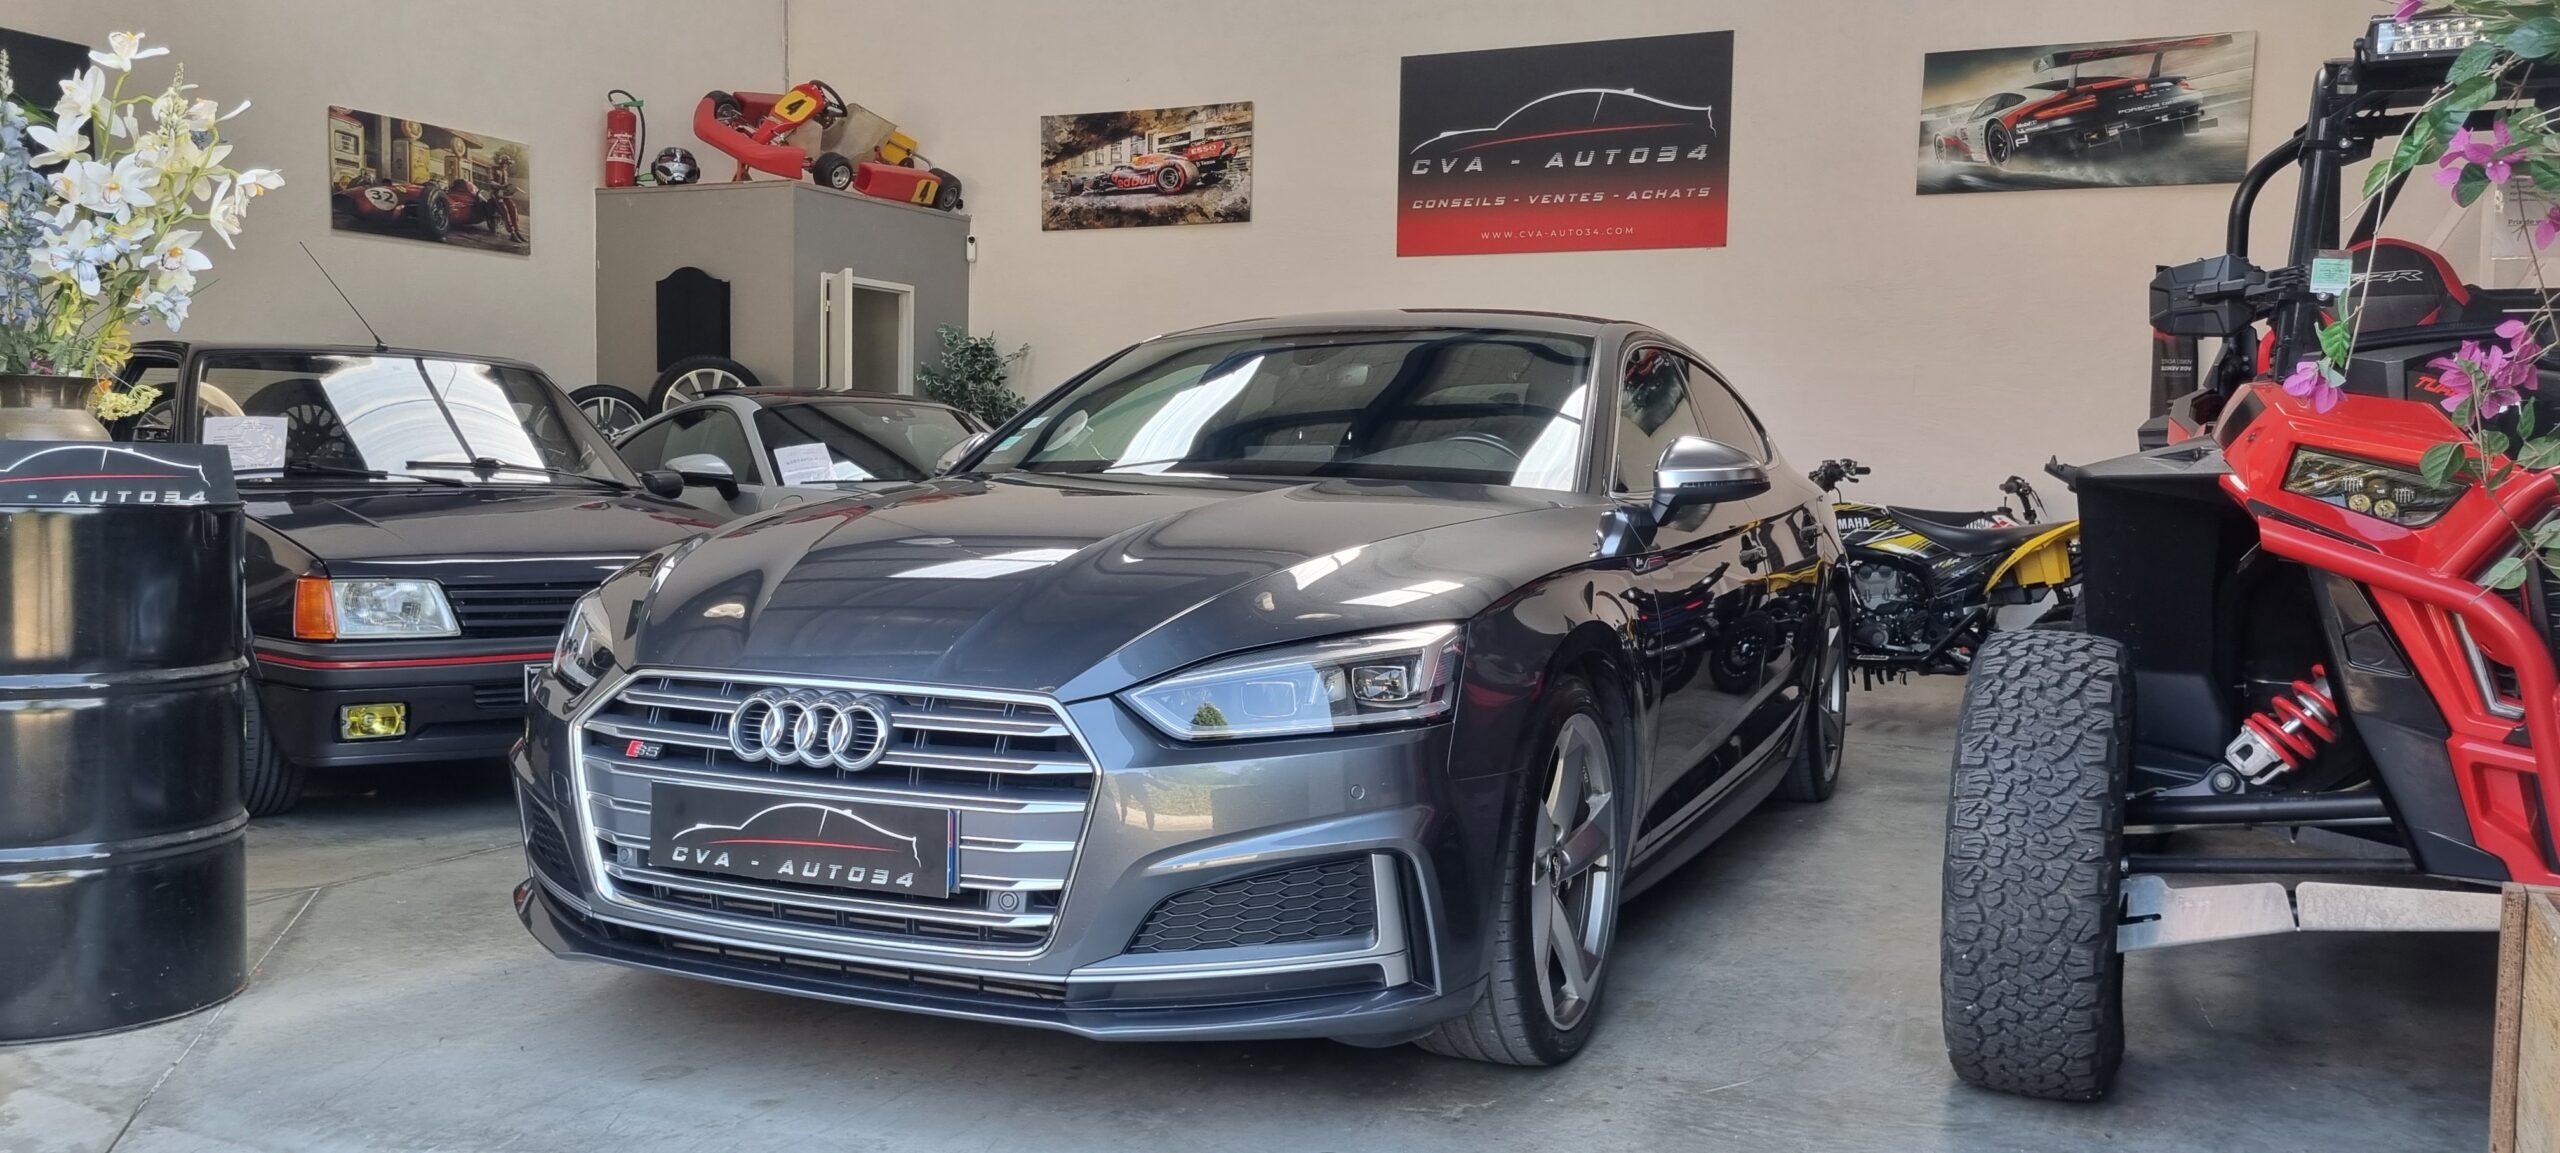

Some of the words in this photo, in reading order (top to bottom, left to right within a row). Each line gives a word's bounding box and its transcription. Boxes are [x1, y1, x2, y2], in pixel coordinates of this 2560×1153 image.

[785, 99, 807, 116] 4
[1411, 156, 1483, 175] CVA
[1545, 144, 1708, 169] AUTO34
[370, 190, 394, 204] 32
[918, 181, 932, 203] 4
[1412, 196, 1507, 210] CONSEILS
[1528, 191, 1605, 205] VENTES
[1626, 187, 1712, 201] ACHATS
[1480, 226, 1634, 240] WWW.CVA-AUTO34.COM
[1838, 517, 1871, 530] MAHA
[672, 846, 730, 868] CVA
[777, 859, 914, 888] AUTO34
